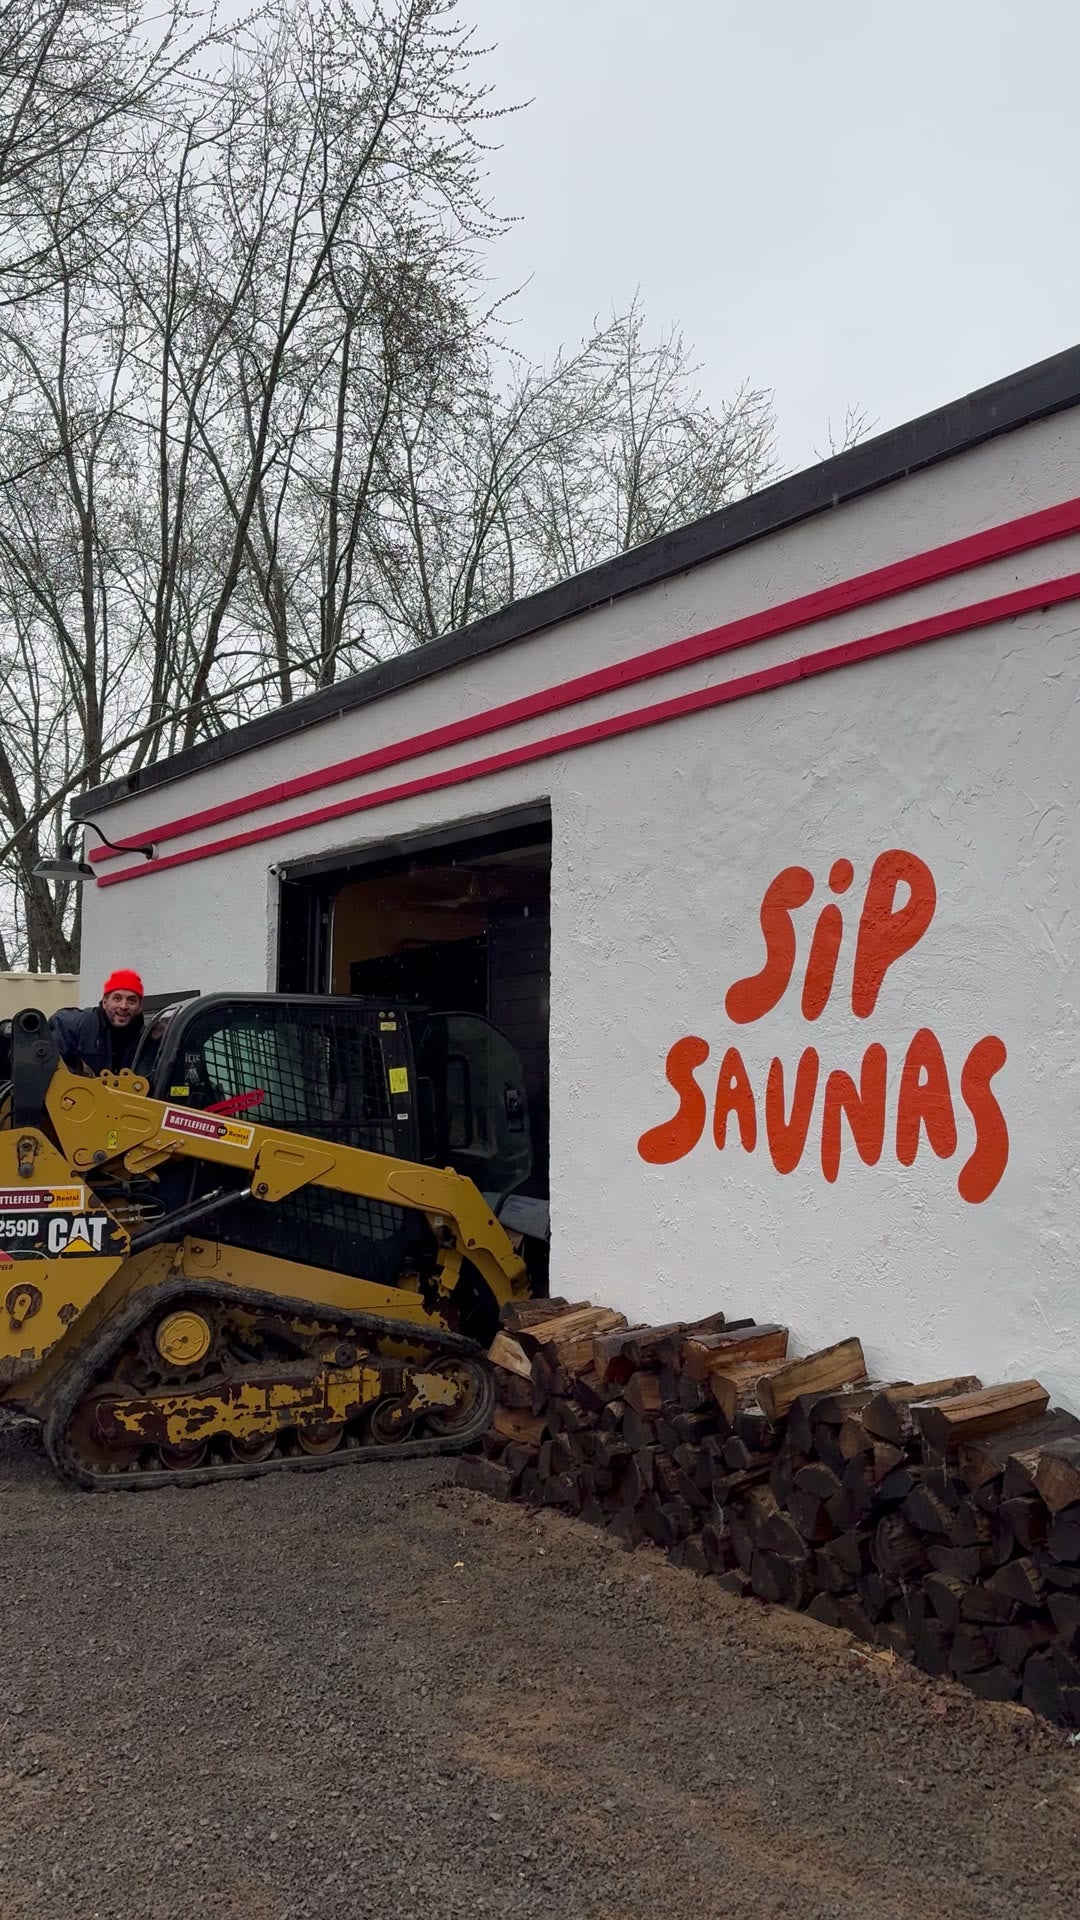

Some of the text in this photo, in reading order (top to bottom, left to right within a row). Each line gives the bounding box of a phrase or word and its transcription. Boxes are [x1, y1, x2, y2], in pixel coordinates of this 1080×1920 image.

[169, 1115, 216, 1133] BATTLEFIELD
[228, 1130, 249, 1140] Rental
[638, 1028, 1009, 1204] SAUNAS
[0, 1219, 39, 1237] 259D
[48, 1217, 107, 1253] CAT
